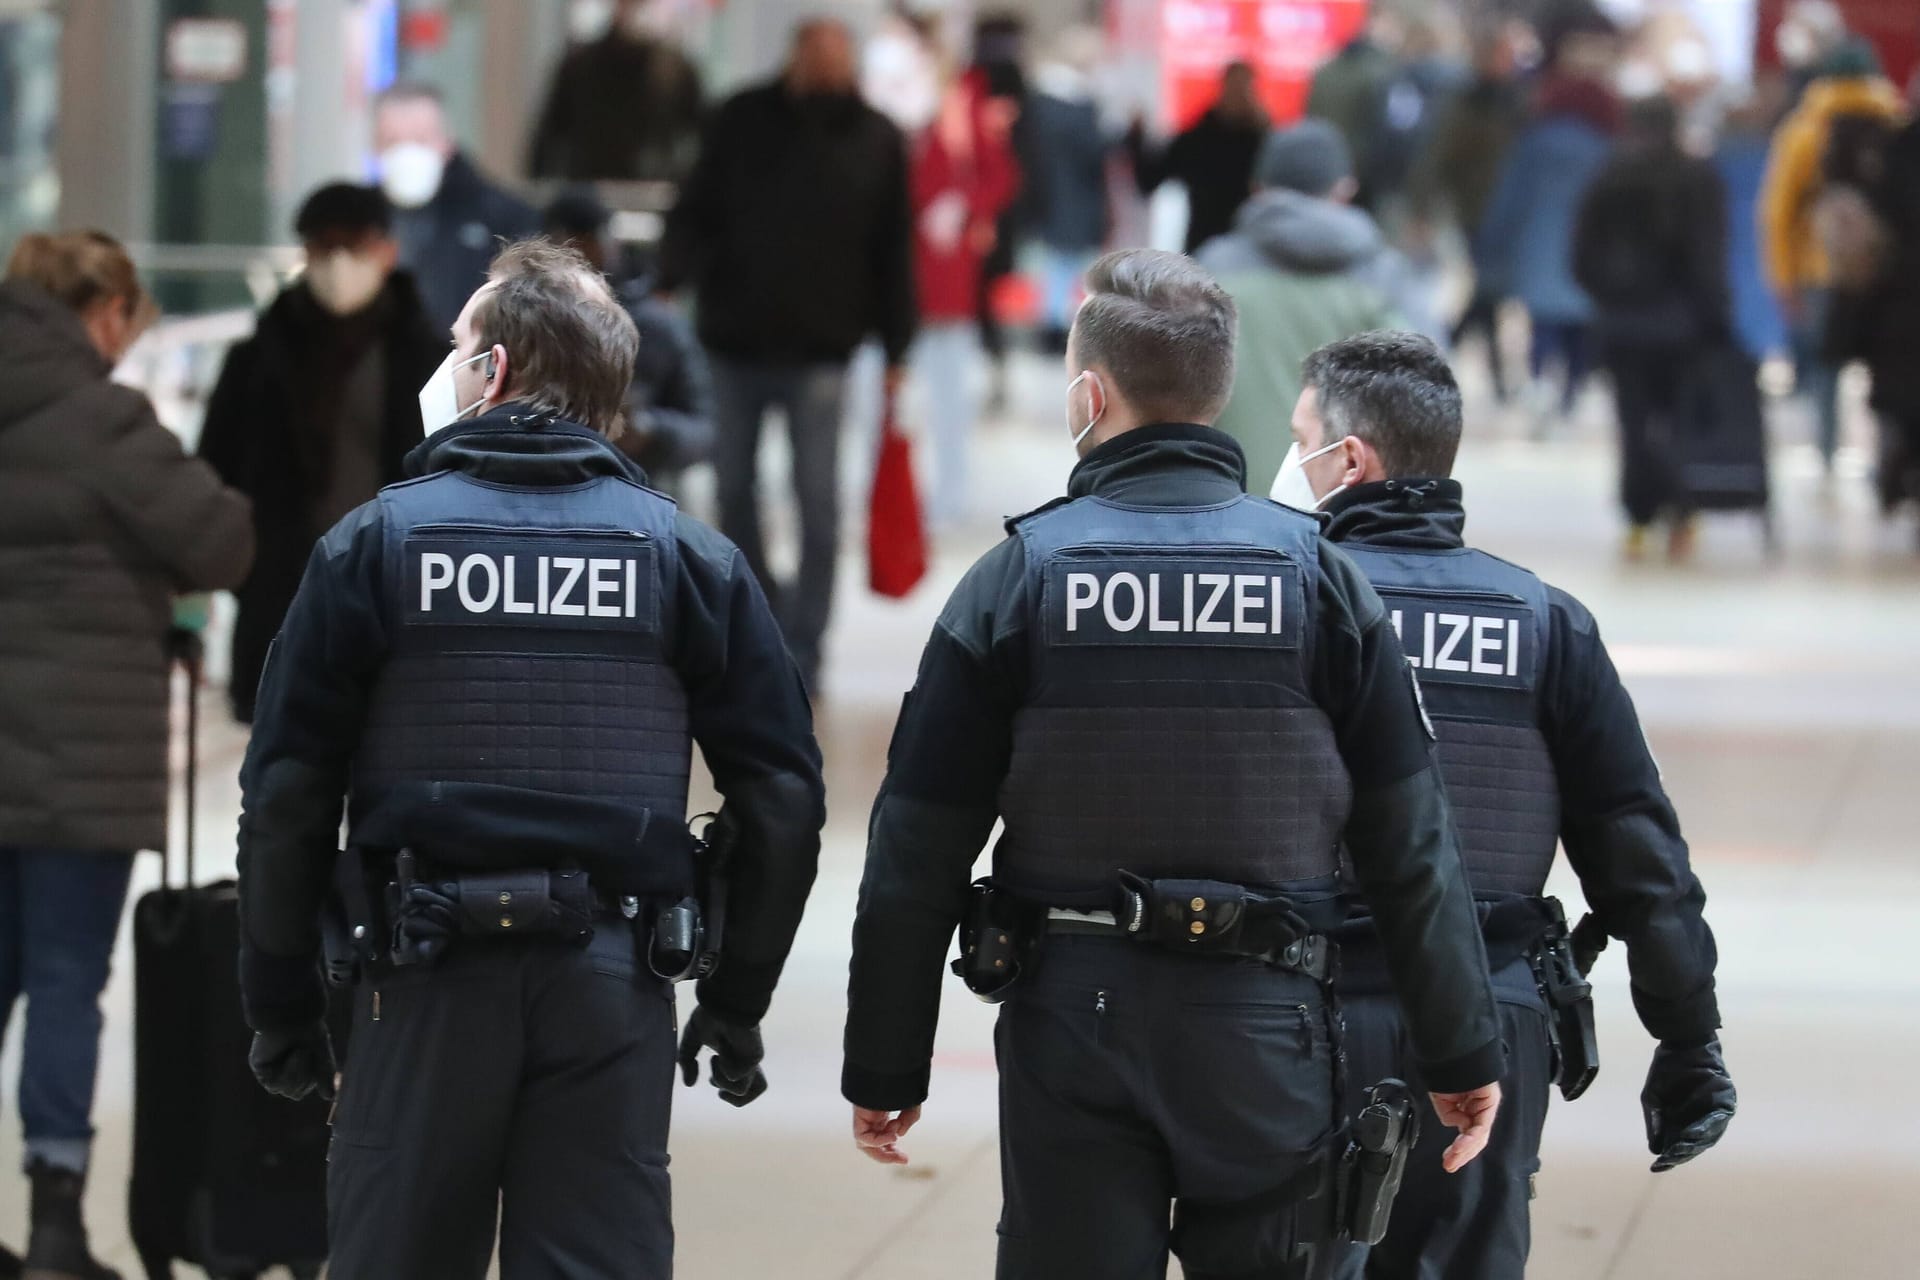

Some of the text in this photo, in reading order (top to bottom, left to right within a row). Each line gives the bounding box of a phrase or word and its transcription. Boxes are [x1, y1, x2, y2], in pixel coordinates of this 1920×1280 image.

[420, 552, 637, 618] POLIZEI
[1066, 571, 1282, 635] POLIZEI
[1391, 609, 1520, 677] LIZEI
